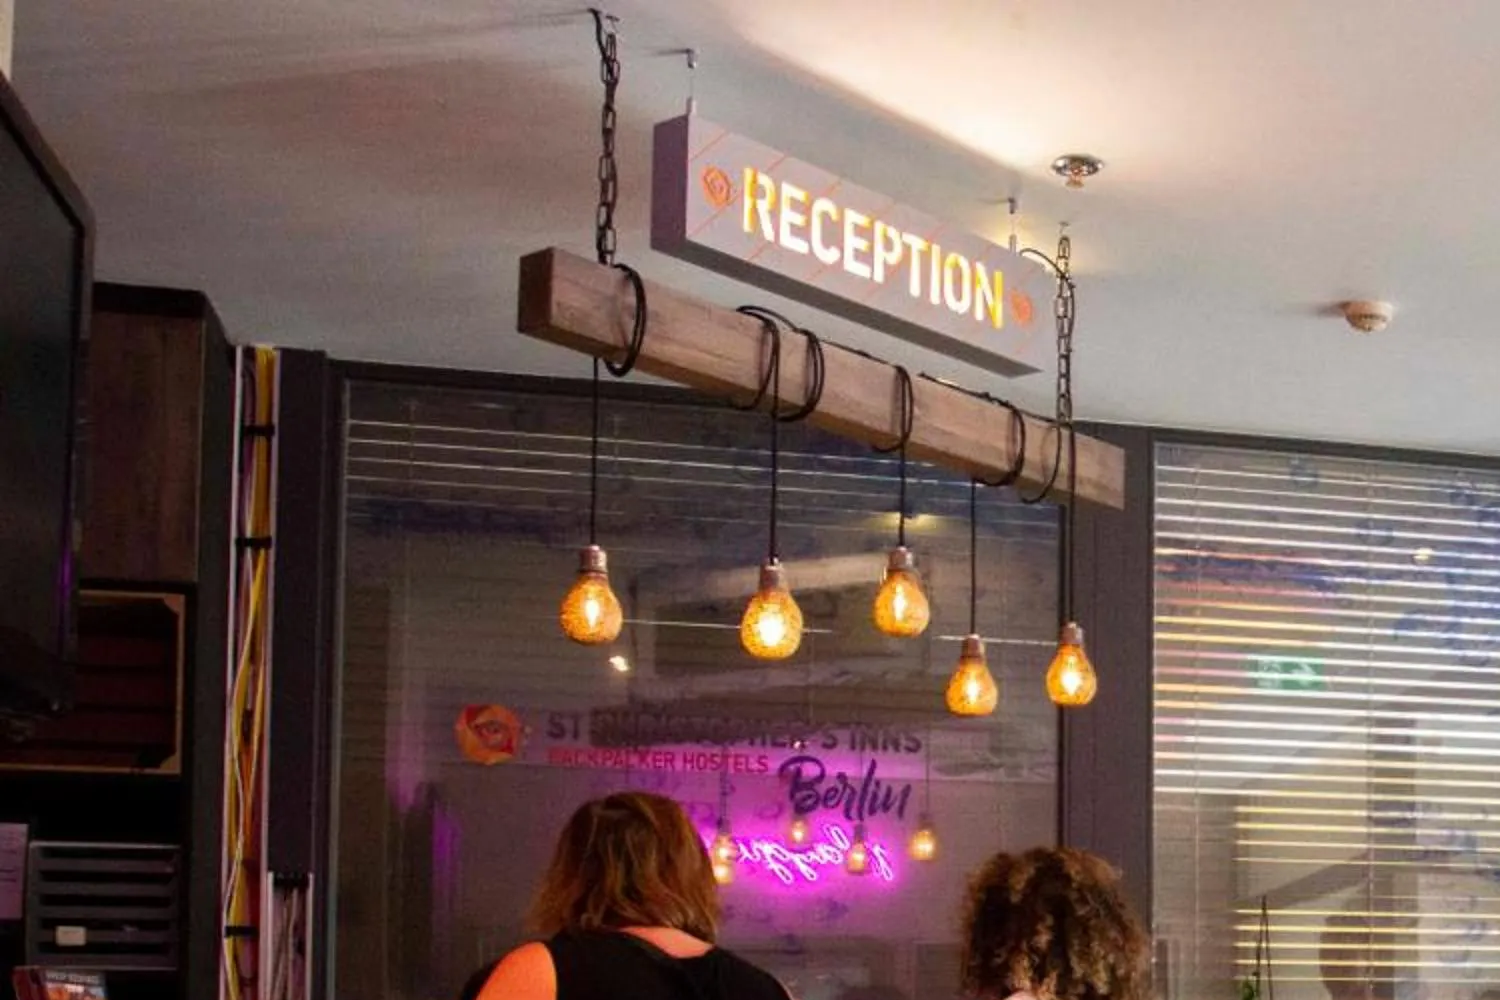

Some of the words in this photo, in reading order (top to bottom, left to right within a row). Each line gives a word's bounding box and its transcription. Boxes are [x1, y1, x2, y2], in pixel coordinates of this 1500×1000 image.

[741, 167, 1003, 329] RECEPTION
[546, 711, 581, 740] ST
[850, 723, 923, 753] INNS
[682, 751, 769, 774] HOSTELS
[778, 755, 912, 822] Berlin
